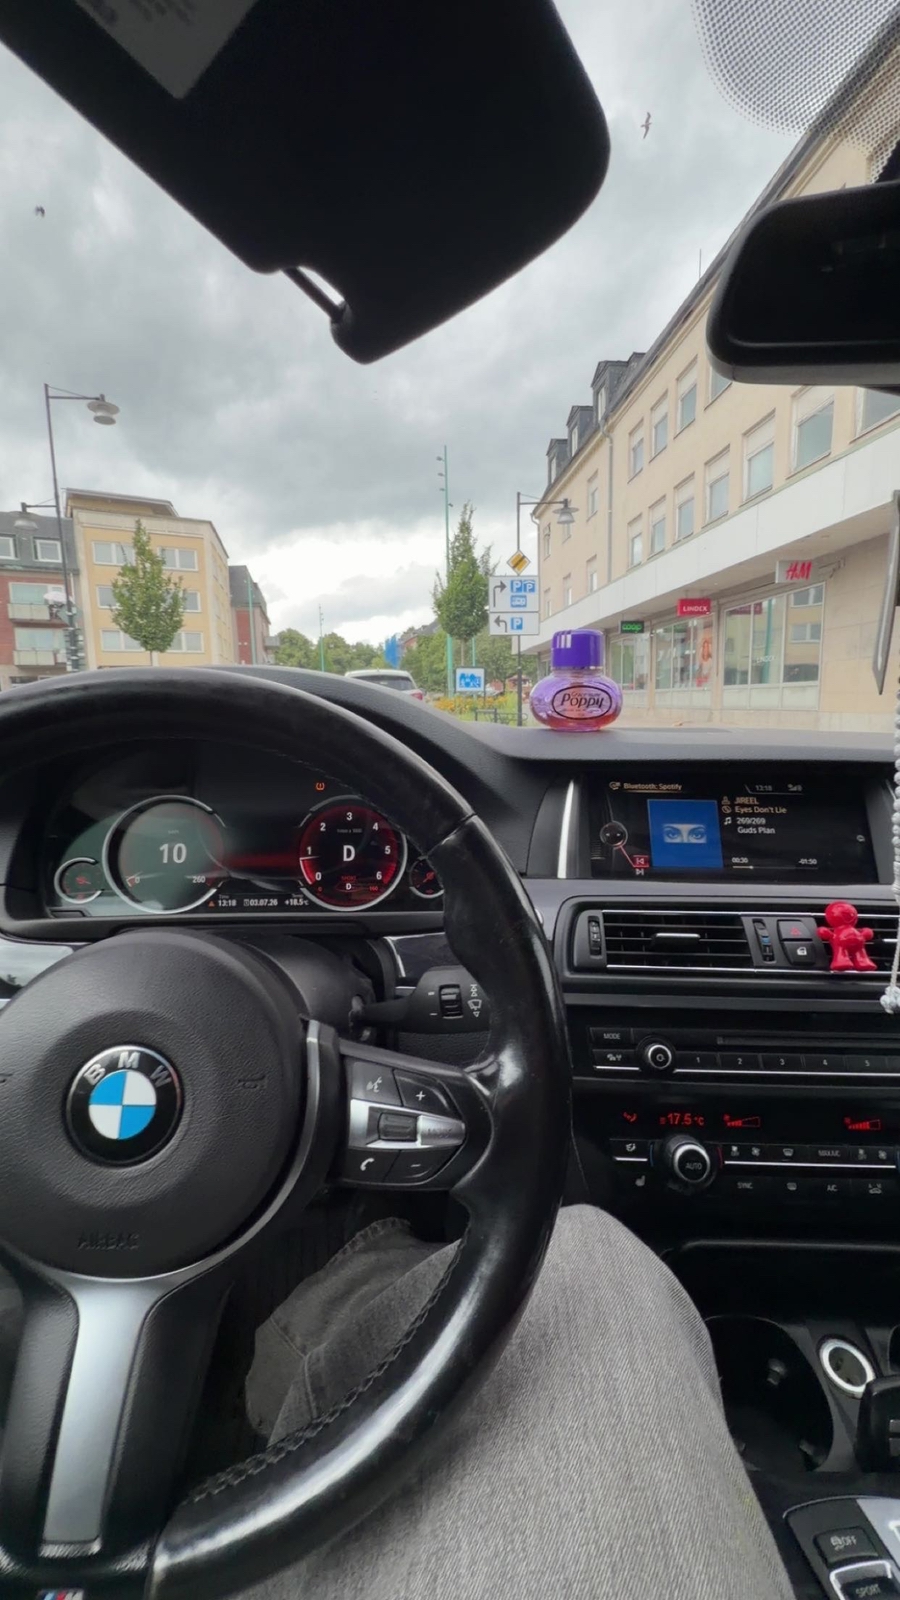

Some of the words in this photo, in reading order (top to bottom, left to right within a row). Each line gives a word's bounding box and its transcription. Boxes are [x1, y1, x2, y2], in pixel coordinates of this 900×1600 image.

[560, 692, 605, 709] Poppy
[623, 782, 658, 790] Bluetooth:
[346, 811, 353, 821] 3
[320, 822, 326, 832] 2
[372, 822, 379, 831] 4
[737, 826, 757, 834] Guds
[159, 843, 187, 864] 10
[306, 846, 312, 855] 1
[342, 844, 356, 862] D
[384, 845, 391, 855] 5
[134, 876, 141, 884] 0
[315, 871, 322, 881] 0
[376, 871, 383, 880] 6
[345, 882, 352, 890] D
[737, 1057, 743, 1065] 2
[780, 1058, 785, 1066] 3
[84, 1051, 173, 1087] BMW
[667, 1113, 692, 1125] 17.5
[855, 1583, 881, 1598] SPORT
